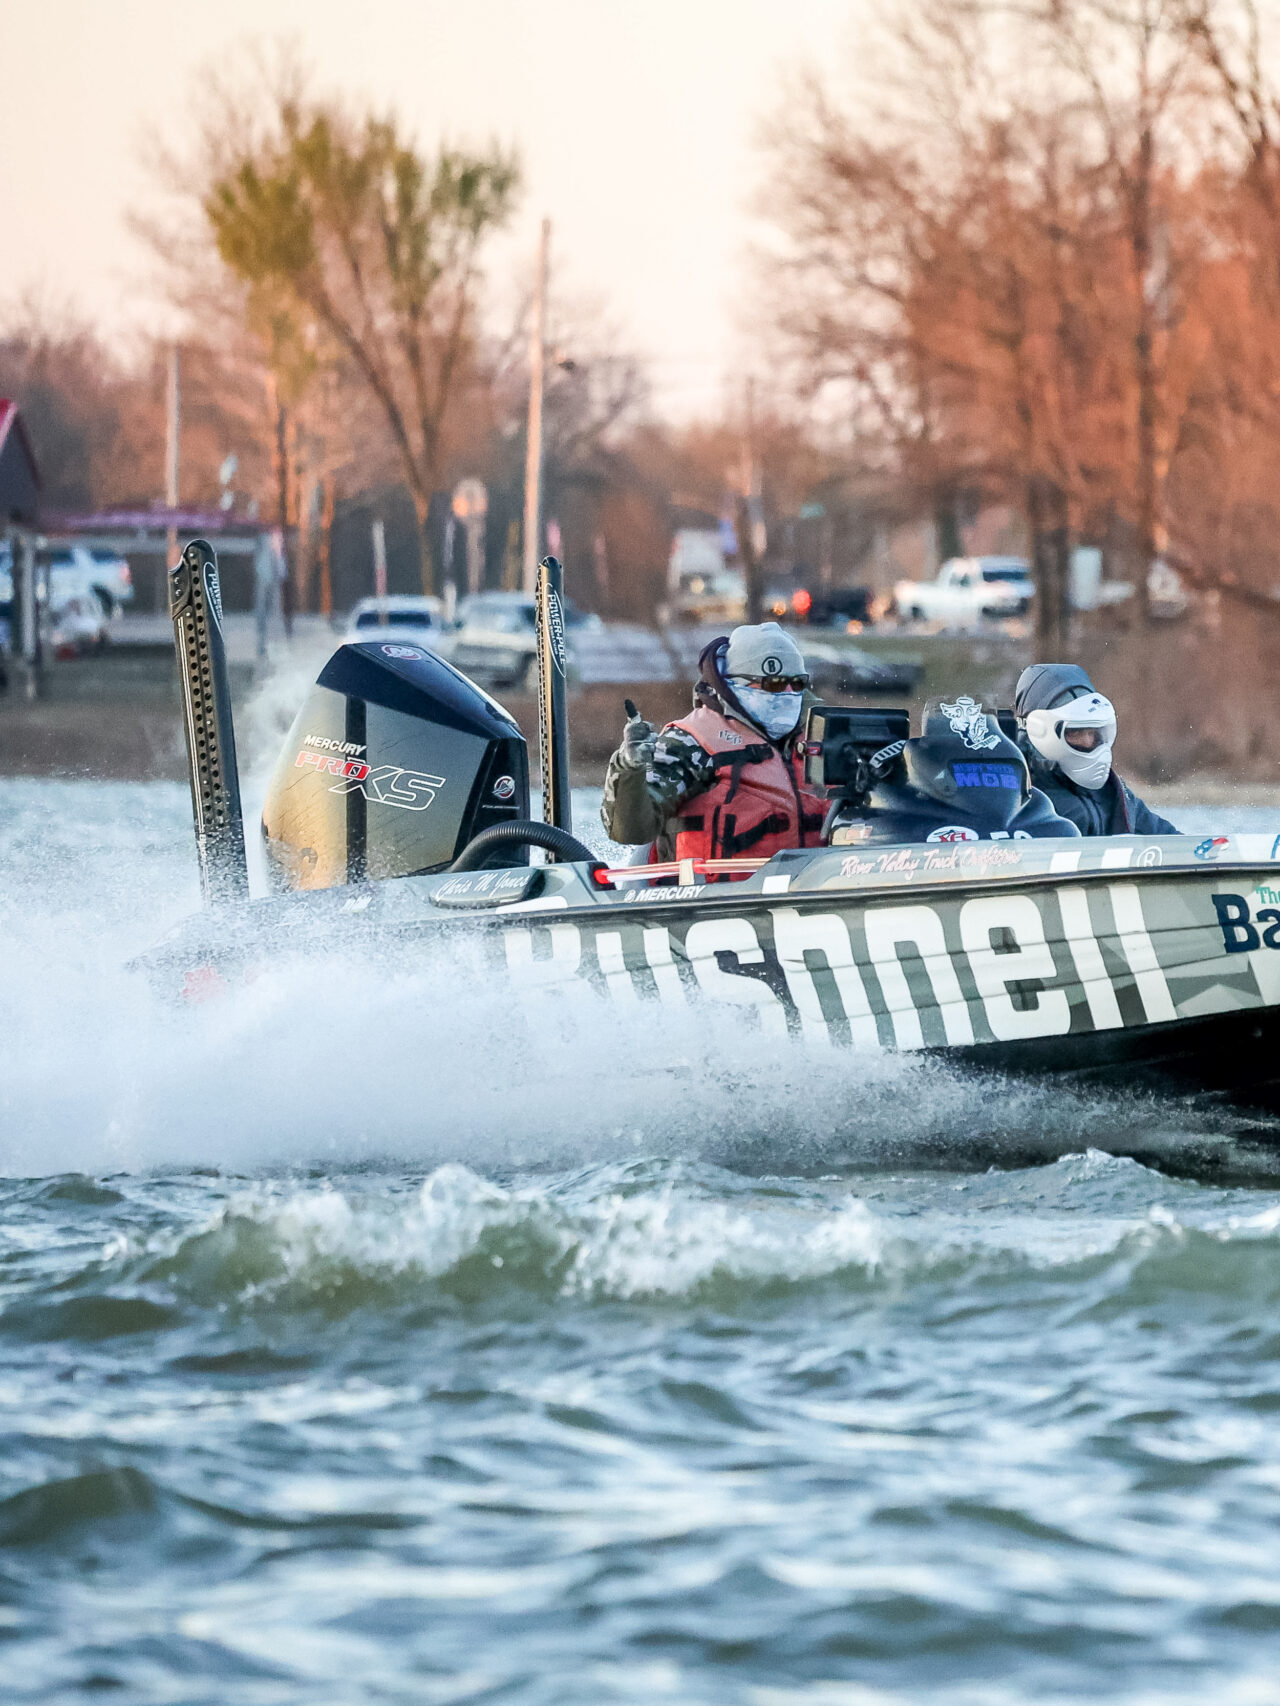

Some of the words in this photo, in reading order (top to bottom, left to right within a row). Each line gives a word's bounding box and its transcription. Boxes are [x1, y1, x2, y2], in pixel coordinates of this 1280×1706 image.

[304, 734, 367, 756] MERCURY
[295, 750, 372, 781] PRO
[328, 765, 446, 811] XS
[840, 855, 876, 877] River
[877, 849, 920, 880] Valley
[924, 846, 960, 870] Truck
[435, 877, 473, 901] Chris
[488, 871, 530, 898] Jones
[634, 885, 706, 903] MERCURY
